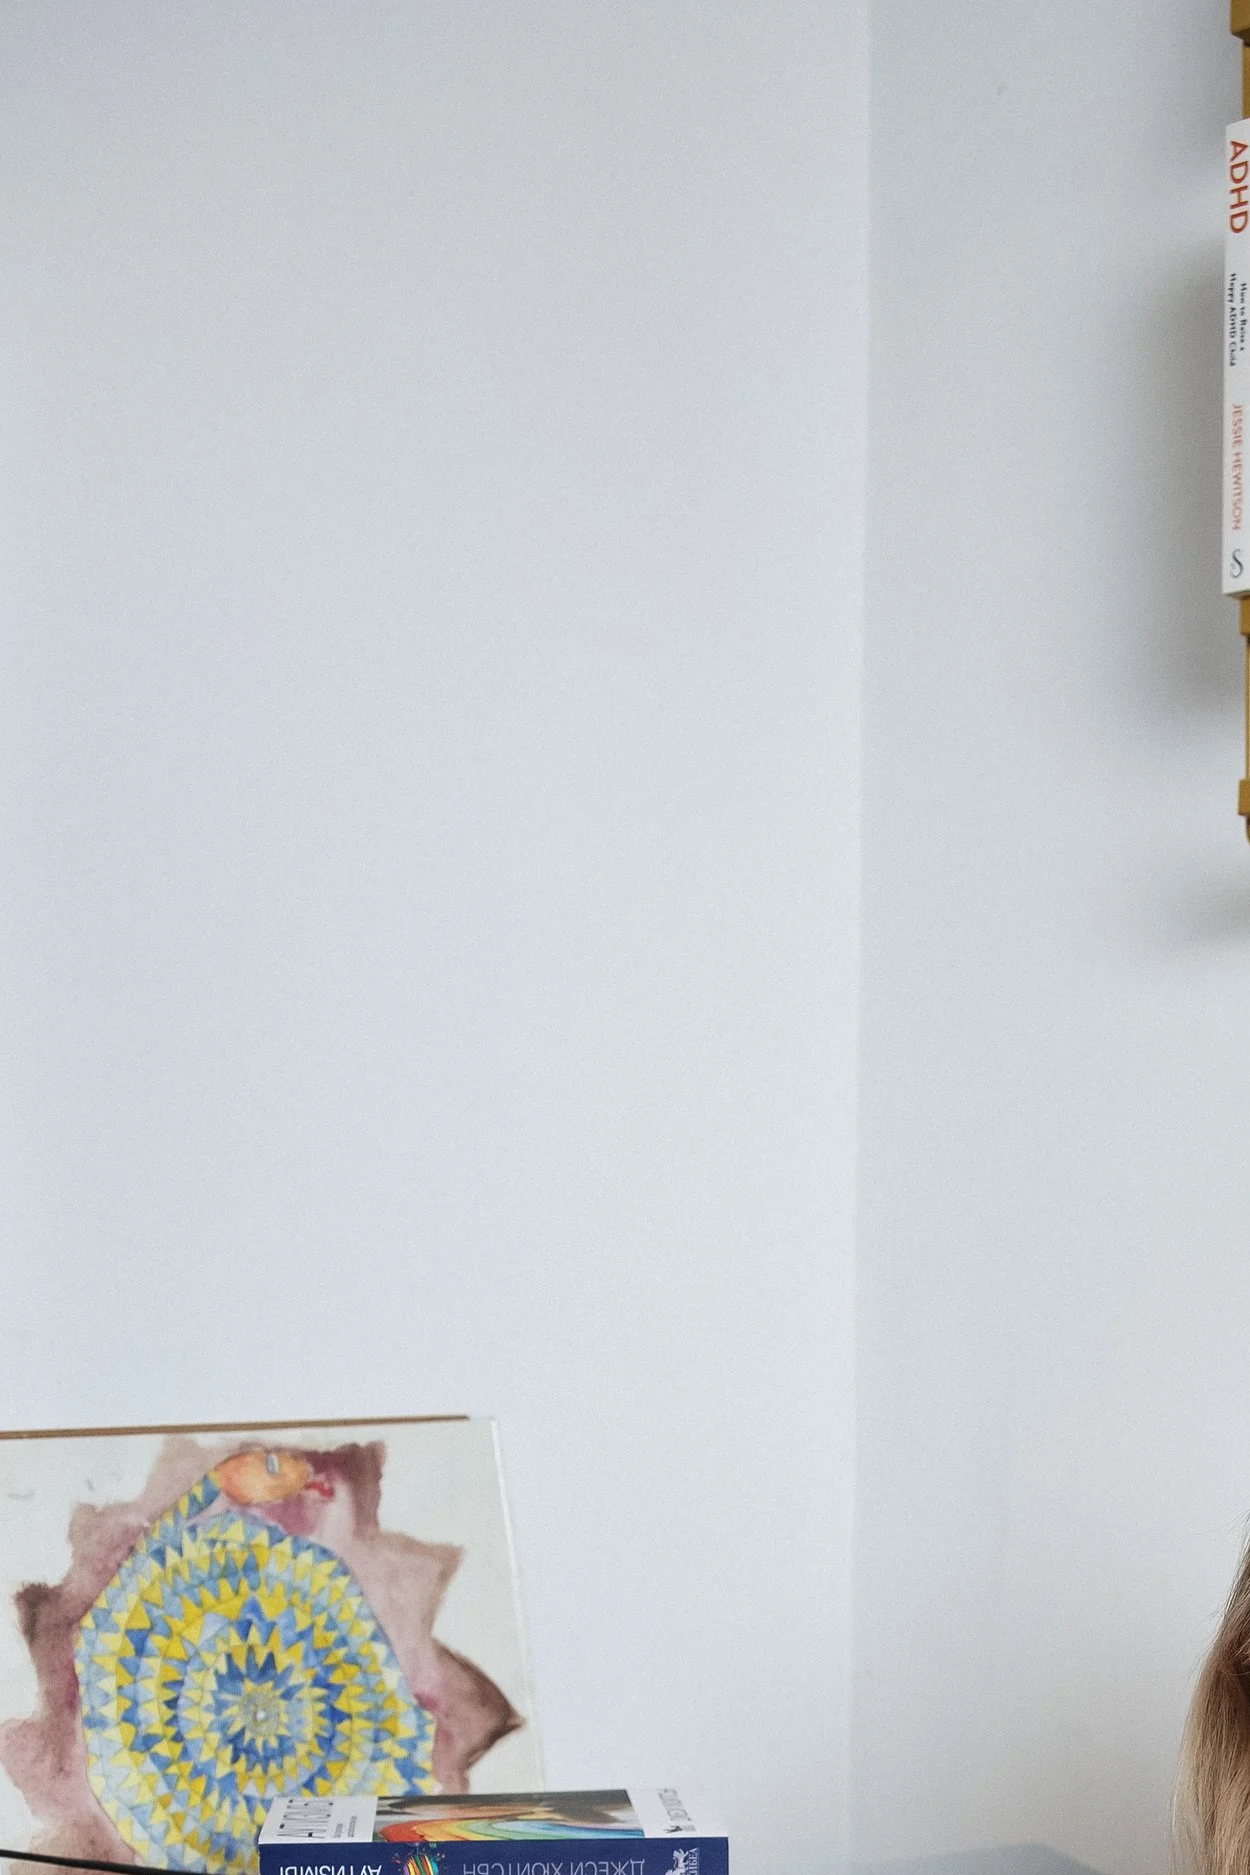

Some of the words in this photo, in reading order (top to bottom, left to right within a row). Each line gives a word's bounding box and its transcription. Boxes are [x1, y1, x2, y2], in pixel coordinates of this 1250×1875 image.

[1230, 140, 1248, 233] ADHD
[1232, 404, 1243, 450] JESSIE
[1232, 452, 1242, 530] HEWITSON
